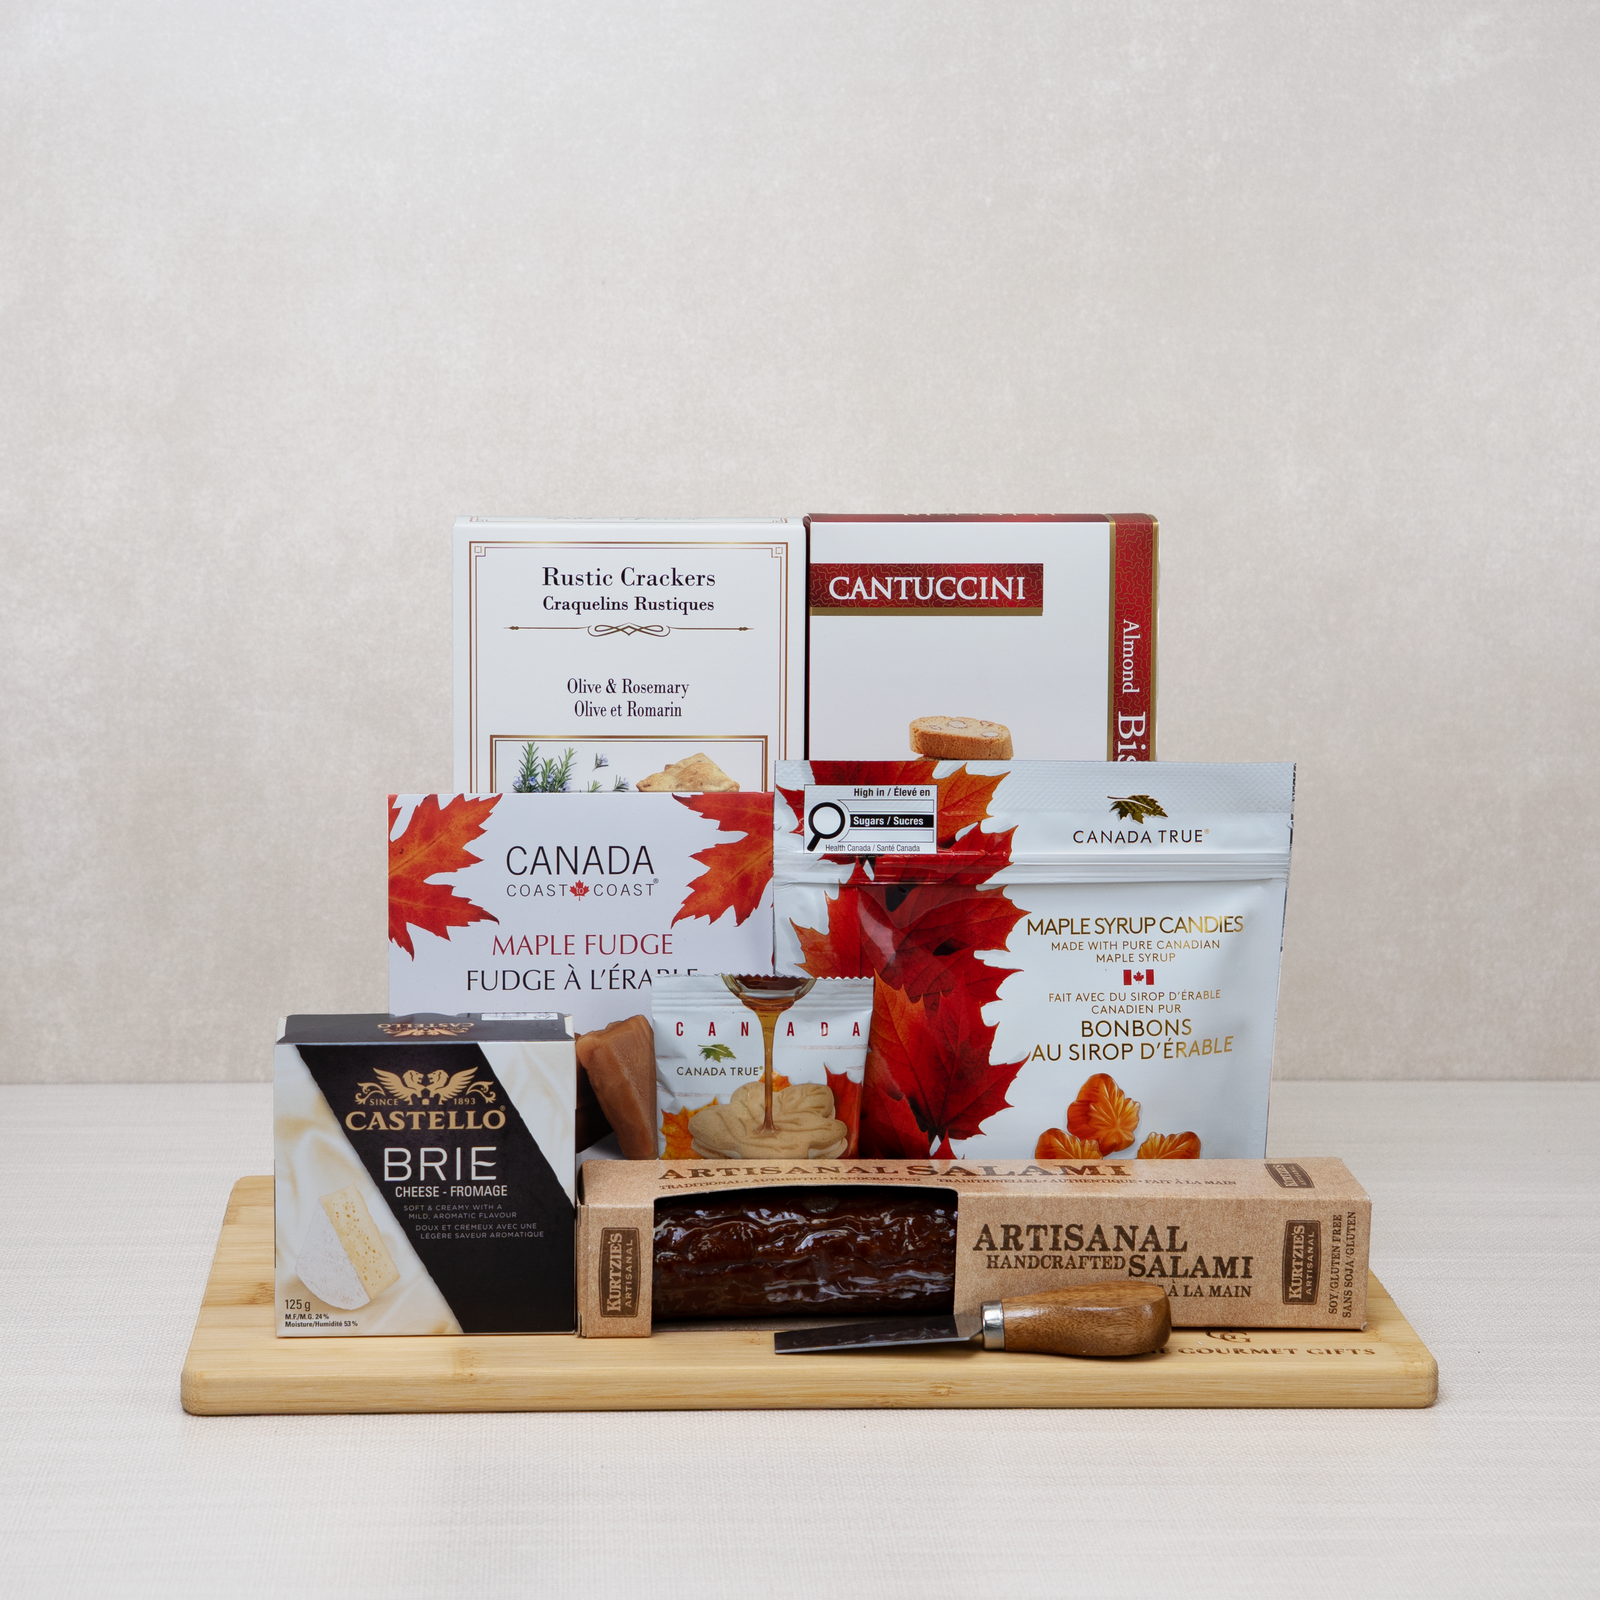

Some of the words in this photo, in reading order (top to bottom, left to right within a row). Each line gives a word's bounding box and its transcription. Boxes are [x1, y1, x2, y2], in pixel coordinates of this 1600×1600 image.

[542, 567, 613, 587] Rustic
[620, 567, 716, 587] Crackers
[828, 576, 1025, 600] CANTUCCINI
[543, 595, 629, 615] Craquelins
[634, 596, 714, 615] Rustiques
[1123, 619, 1141, 694] Almond
[567, 678, 601, 694] Olive
[606, 679, 617, 694] &
[622, 679, 689, 698] Rosemary
[574, 701, 606, 718] Olive
[610, 704, 622, 718] et
[627, 702, 682, 718] Romarin
[854, 788, 874, 798] High
[876, 788, 884, 796] in
[887, 788, 891, 796] /
[894, 786, 917, 797] Élevé
[853, 816, 884, 827] Sugars
[886, 816, 891, 825] /
[893, 816, 924, 826] Sucres
[1073, 830, 1152, 844] CANADA
[1158, 829, 1203, 843] TRUE
[825, 844, 846, 852] Health
[847, 844, 871, 852] Canada
[877, 844, 895, 852] Santé
[896, 844, 920, 852] Canada
[506, 845, 655, 876] CANADA
[506, 884, 568, 897] COAST
[593, 884, 654, 897] COAST
[1027, 918, 1091, 936] MAPLE
[1094, 917, 1156, 935] SYRUP
[1159, 915, 1243, 934] CANDIES
[492, 934, 575, 956] MAPLE
[585, 933, 673, 955] FUDGE
[1051, 941, 1084, 951] MADE
[1088, 941, 1117, 950] WITH
[1123, 940, 1153, 950] PURE
[1157, 940, 1220, 949] CANADIAN
[1096, 953, 1134, 963] MAPLE
[1138, 952, 1176, 963] SYRUP
[467, 969, 555, 991] FUDGE
[564, 963, 581, 990] À
[591, 963, 698, 990] L'ÉRA
[1048, 993, 1072, 1002] FAIT
[1075, 992, 1105, 1002] AVEC
[1110, 992, 1126, 1002] DU
[1130, 991, 1165, 1001] SIROP
[1169, 989, 1221, 1001] D'ÉRABLE
[1091, 1004, 1154, 1015] CANADIEN
[1158, 1004, 1182, 1014] PUR
[676, 1021, 861, 1037] CANADA
[1081, 1018, 1192, 1038] BONBONS
[1031, 1044, 1061, 1062] AU
[1069, 1043, 1134, 1061] SIROP
[1141, 1036, 1234, 1060] D'ÉRABLE
[677, 1066, 726, 1076] CANADA
[731, 1067, 759, 1076] TRUE
[370, 1098, 399, 1106] SINCE
[345, 1109, 506, 1131] CASTELLO
[384, 1146, 497, 1182] BRIE
[658, 1166, 898, 1179] ARTISANAL
[906, 1165, 1131, 1176] SALAMI
[395, 1186, 439, 1198] CHEESE
[450, 1185, 508, 1197] FROMAGE
[659, 1180, 743, 1190] TRADITIONAL
[420, 1232, 452, 1240] LÉGÈRE
[454, 1222, 493, 1231] CRÉMEUX
[1332, 1214, 1342, 1243] FREE
[972, 1224, 1188, 1252] ARTISANAL
[1344, 1211, 1356, 1288] SOJA/GLUTEN
[986, 1254, 1127, 1270] HANDCRAFTED
[1128, 1254, 1254, 1279] SALAMI
[1289, 1225, 1305, 1299] KURTZIE'S
[1305, 1231, 1315, 1295] ARTISANAL
[607, 1232, 623, 1312] KURTZIE'S
[625, 1239, 634, 1308] ARTISANAL
[1328, 1245, 1341, 1315] SOY/GLUTEN
[1167, 1279, 1179, 1297] À
[1183, 1285, 1204, 1297] LA
[1209, 1285, 1252, 1298] MAIN
[285, 1299, 302, 1310] 125
[304, 1301, 311, 1312] g
[1342, 1291, 1353, 1318] SANS
[285, 1320, 343, 1328] Moisture/Humidité
[1178, 1347, 1299, 1355] GOURMET
[1306, 1348, 1376, 1356] GIFTS
